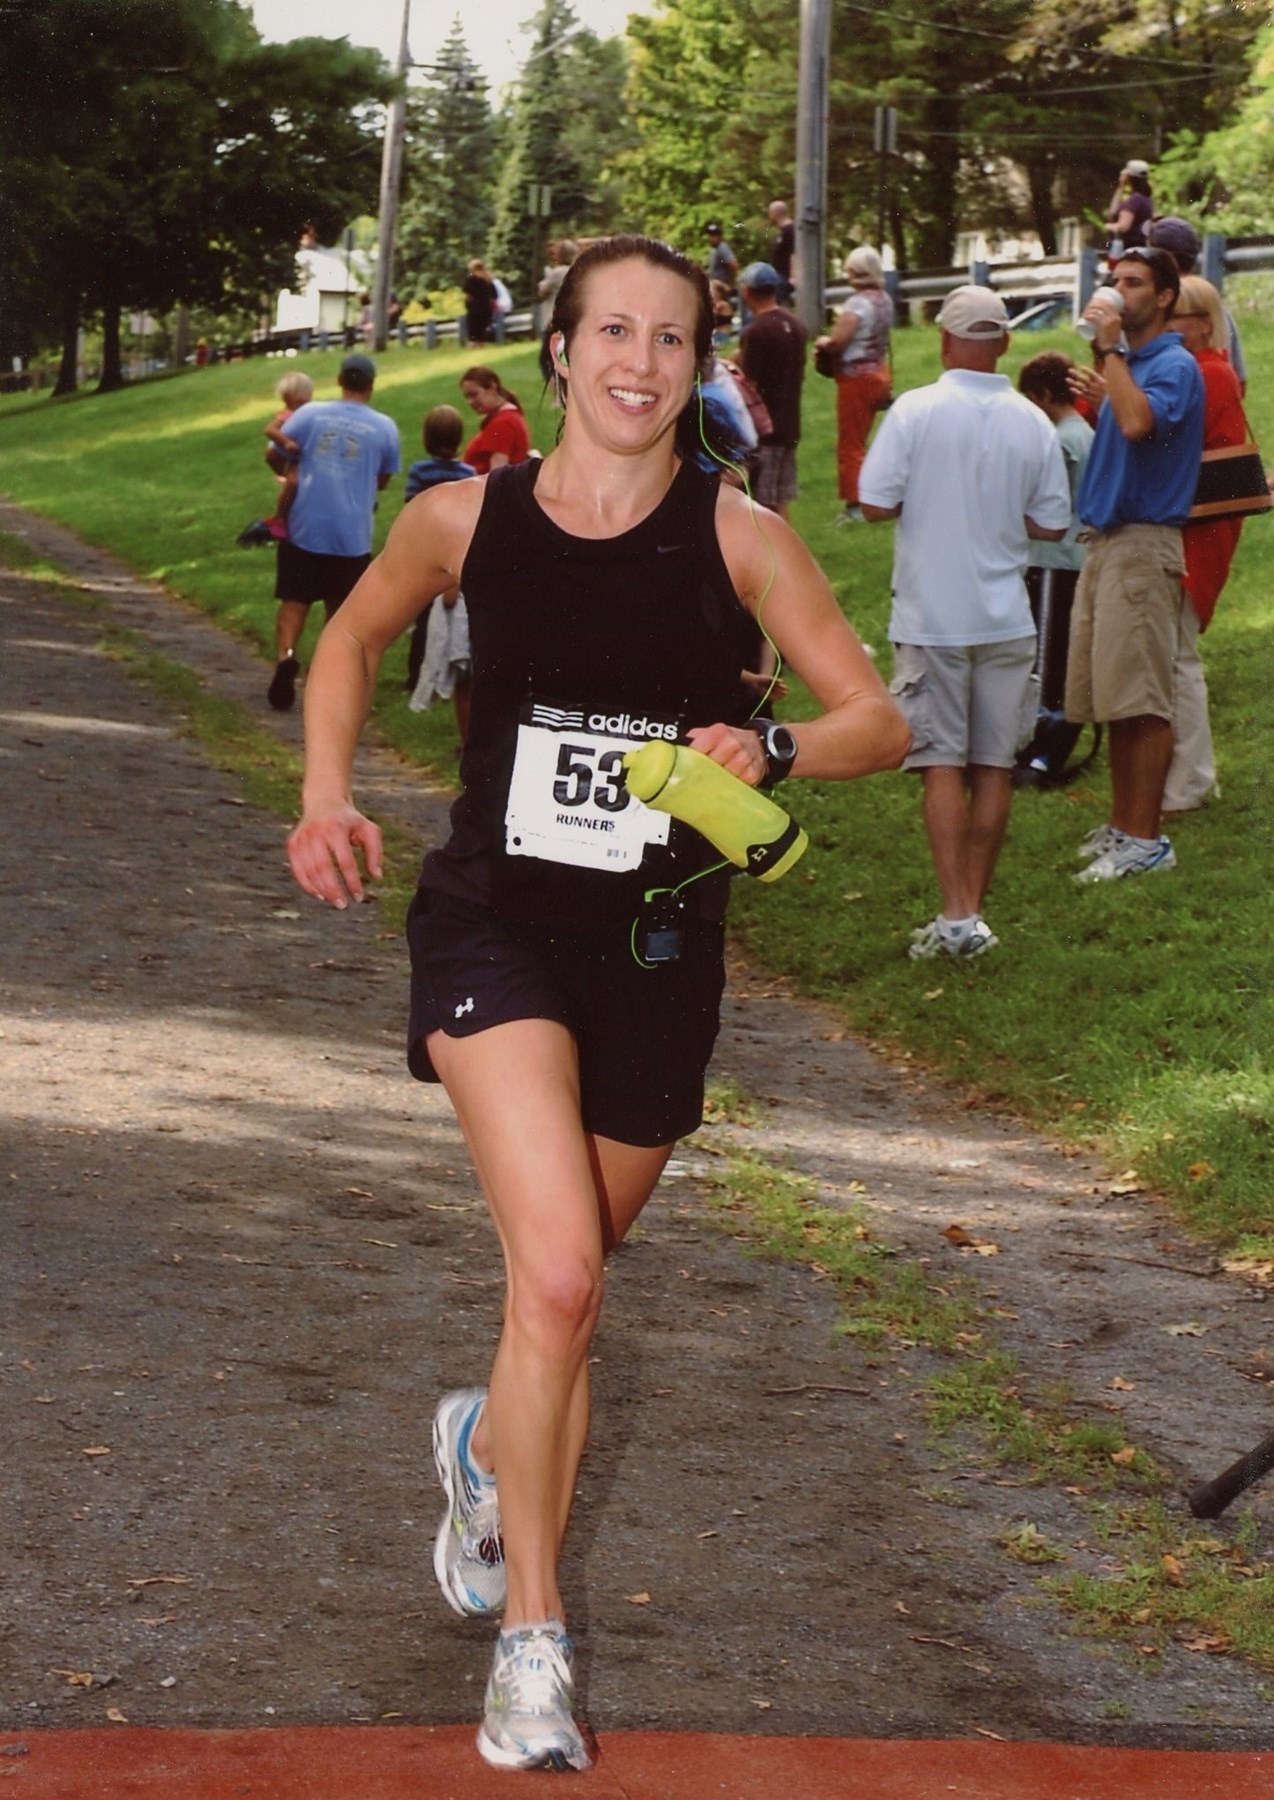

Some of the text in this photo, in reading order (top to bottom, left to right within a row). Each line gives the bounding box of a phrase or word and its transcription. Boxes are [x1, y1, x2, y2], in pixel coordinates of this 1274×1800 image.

[588, 713, 678, 740] adidas
[552, 743, 630, 812] 53
[556, 813, 616, 832] RUNNERS
